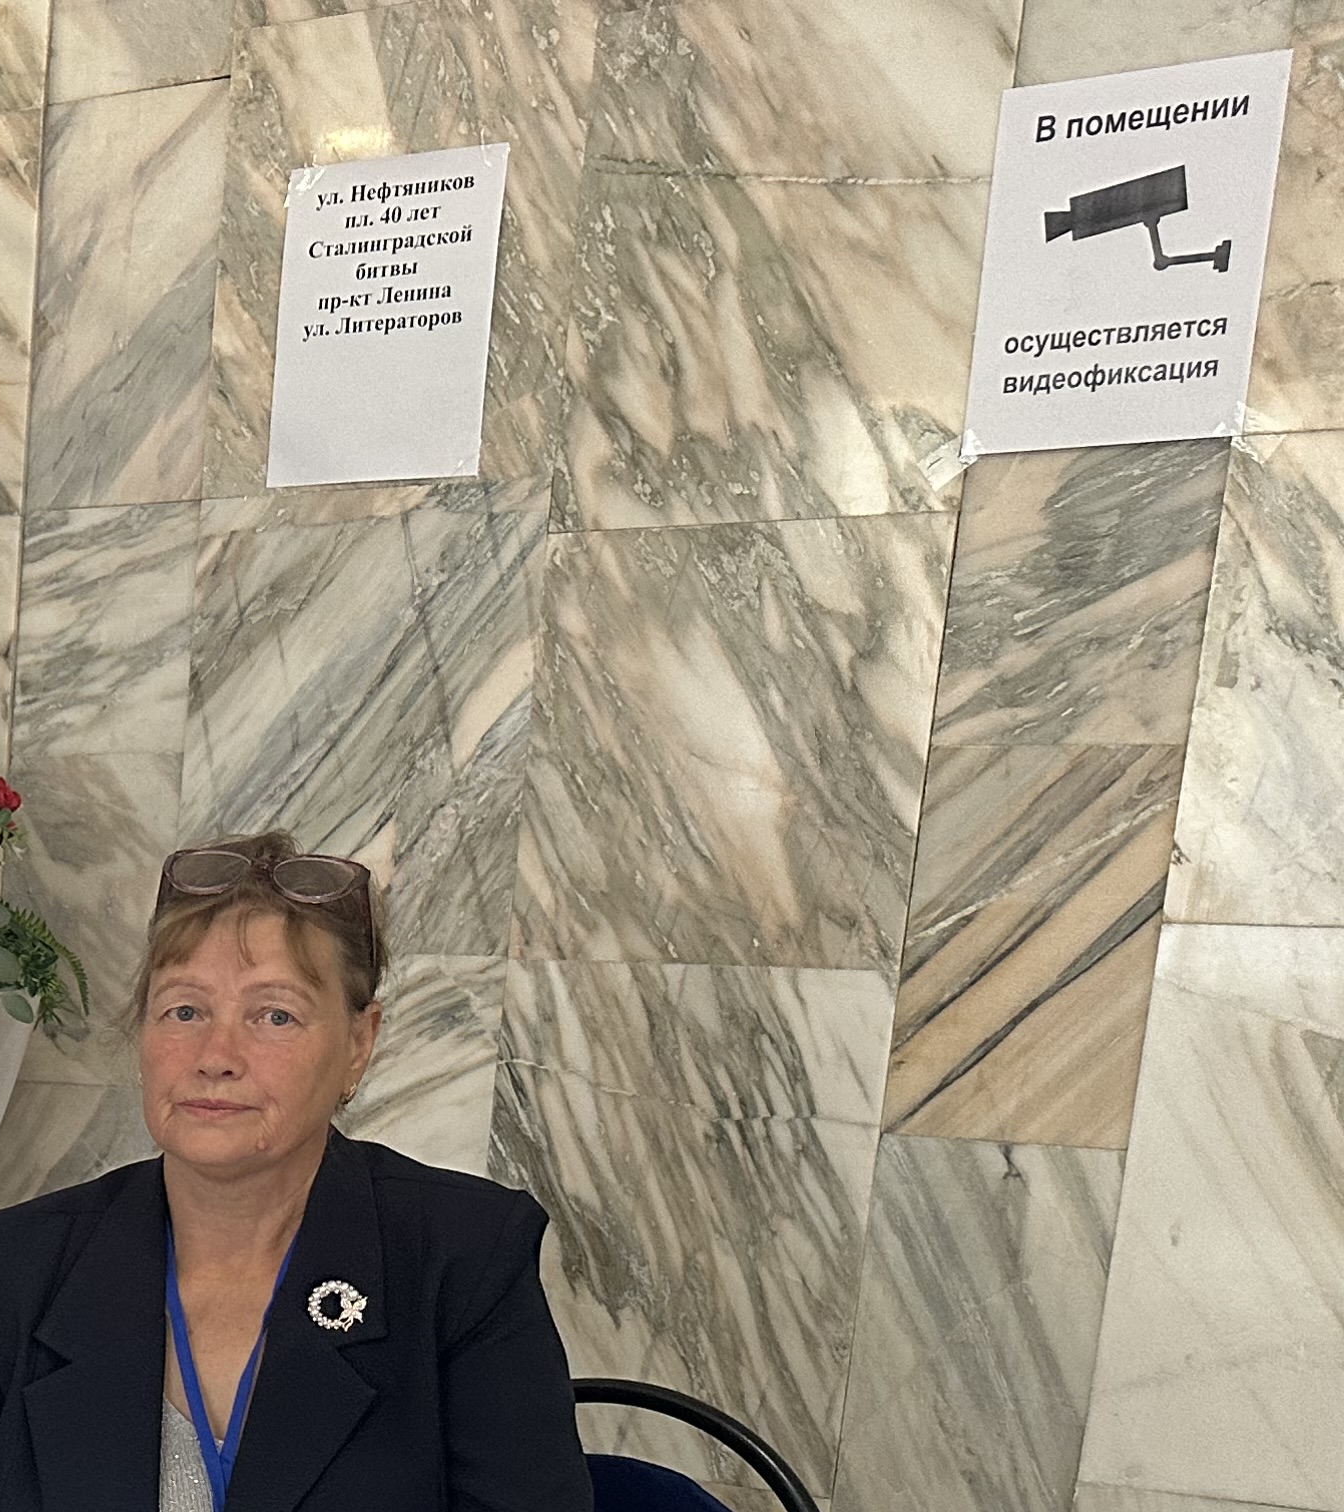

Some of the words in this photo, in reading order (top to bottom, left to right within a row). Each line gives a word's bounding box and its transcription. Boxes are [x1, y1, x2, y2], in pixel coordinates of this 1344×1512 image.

[1035, 114, 1056, 143] В
[1065, 94, 1250, 139] помещении
[315, 191, 344, 212] ул.
[350, 175, 475, 204] Нефтяников
[345, 214, 374, 229] пл.
[379, 207, 402, 225] 40
[406, 206, 442, 222] лет
[308, 224, 473, 259] Сталинградской
[355, 262, 418, 281] битвы
[318, 293, 373, 314] пр-кт
[376, 285, 452, 305] Ленина
[302, 324, 330, 342] ул.
[334, 311, 462, 336] Литераторов
[1004, 317, 1228, 358] осуществляется
[1002, 359, 1220, 397] видеофиксация
